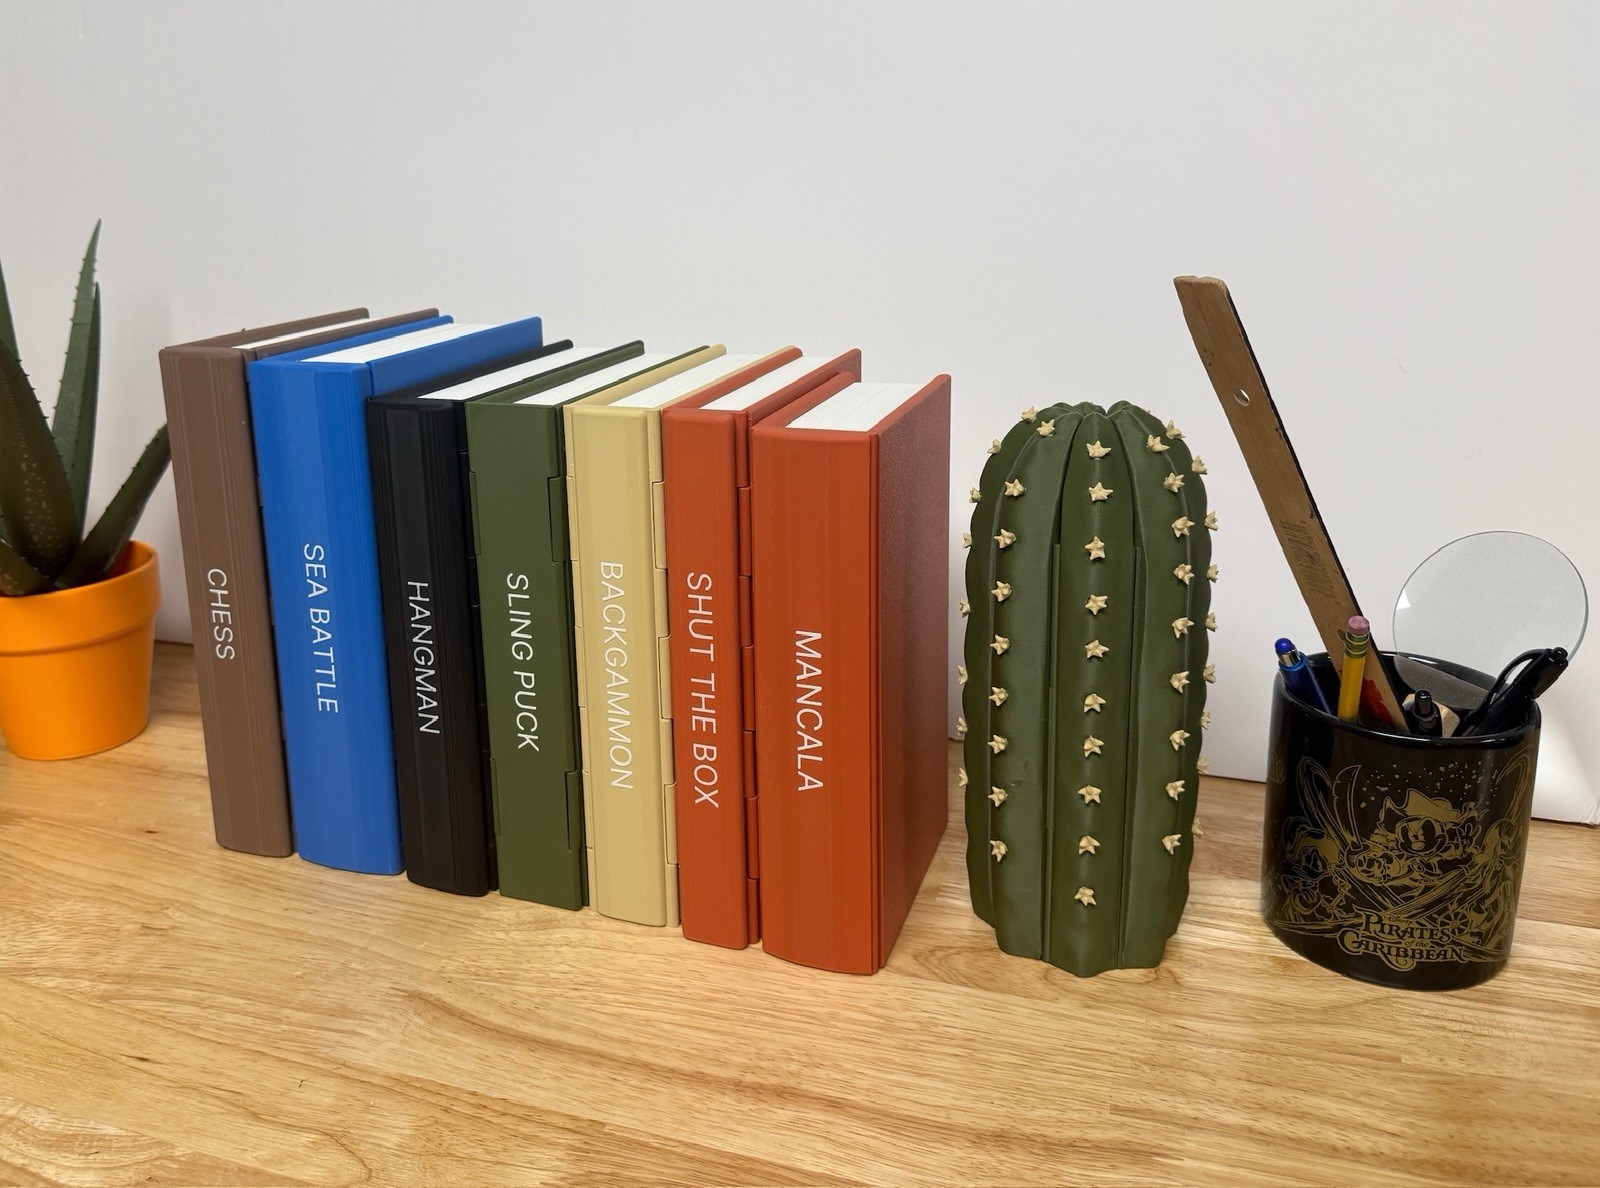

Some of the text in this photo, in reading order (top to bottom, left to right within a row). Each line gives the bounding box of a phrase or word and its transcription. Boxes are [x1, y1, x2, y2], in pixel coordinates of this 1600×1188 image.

[207, 568, 235, 660] CHESS
[304, 543, 338, 714] SEA BATTLE
[407, 580, 440, 734] HANGMAN
[506, 572, 539, 752] SLING PUCK
[600, 561, 634, 790] BACKGAMMON
[686, 572, 719, 808] SHUT THE BOX
[795, 629, 824, 792] MANCALA
[1338, 930, 1467, 967] CARIBBEAN
[1359, 911, 1452, 942] PIRATES
[1404, 939, 1414, 948] of
